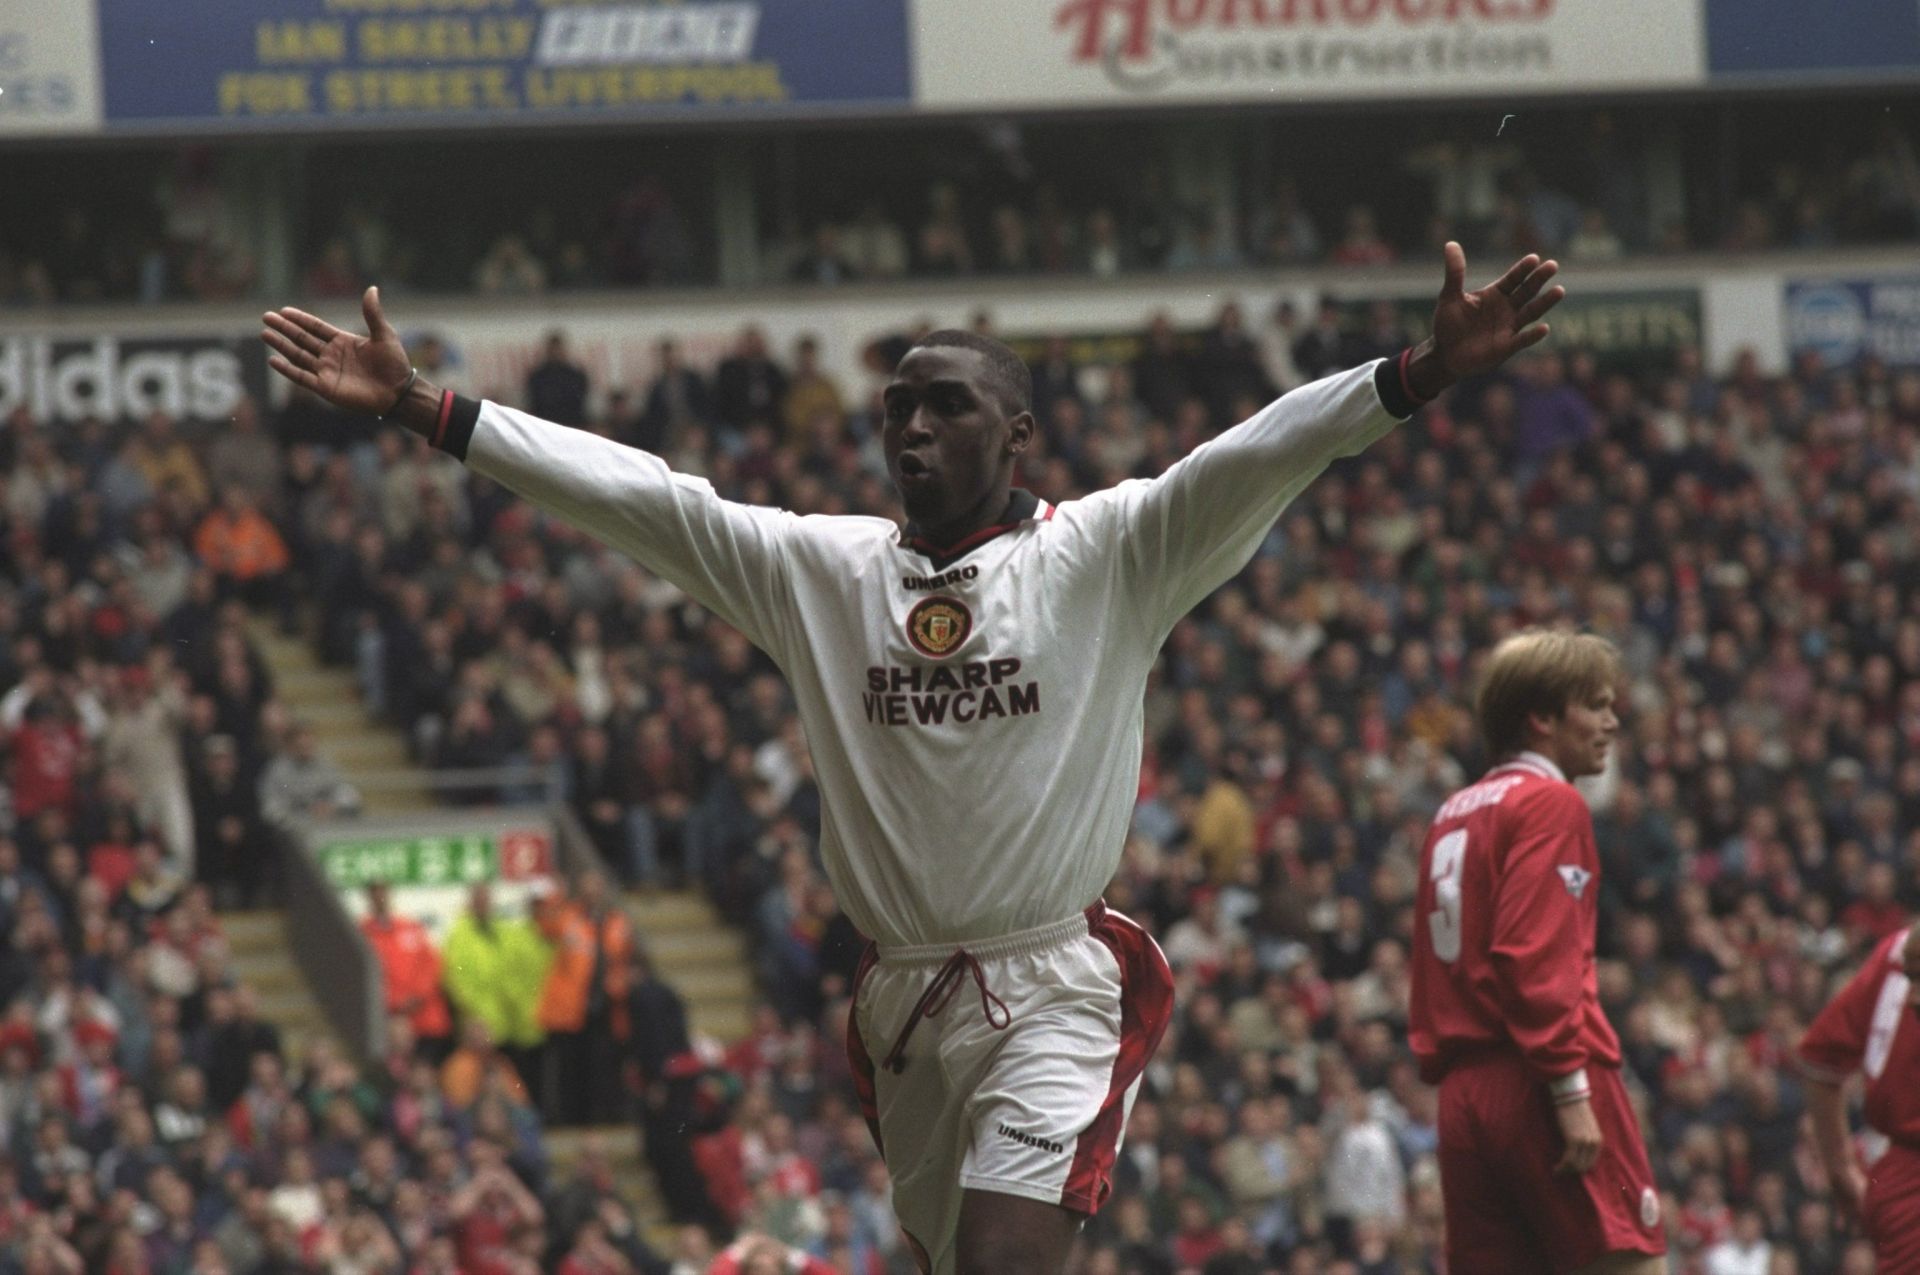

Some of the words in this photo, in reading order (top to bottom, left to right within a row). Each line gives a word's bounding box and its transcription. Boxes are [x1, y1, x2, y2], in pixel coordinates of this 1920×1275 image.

[256, 20, 345, 63] IAN
[358, 14, 533, 60] SKELLY
[1103, 28, 1553, 93] Construction
[217, 71, 308, 115] FOX
[902, 564, 979, 592] UMBRO
[866, 657, 1022, 694] SHARP
[862, 682, 1041, 727] VIEWCAM
[1428, 827, 1469, 965] 3
[997, 1122, 1064, 1154] UMBRO
